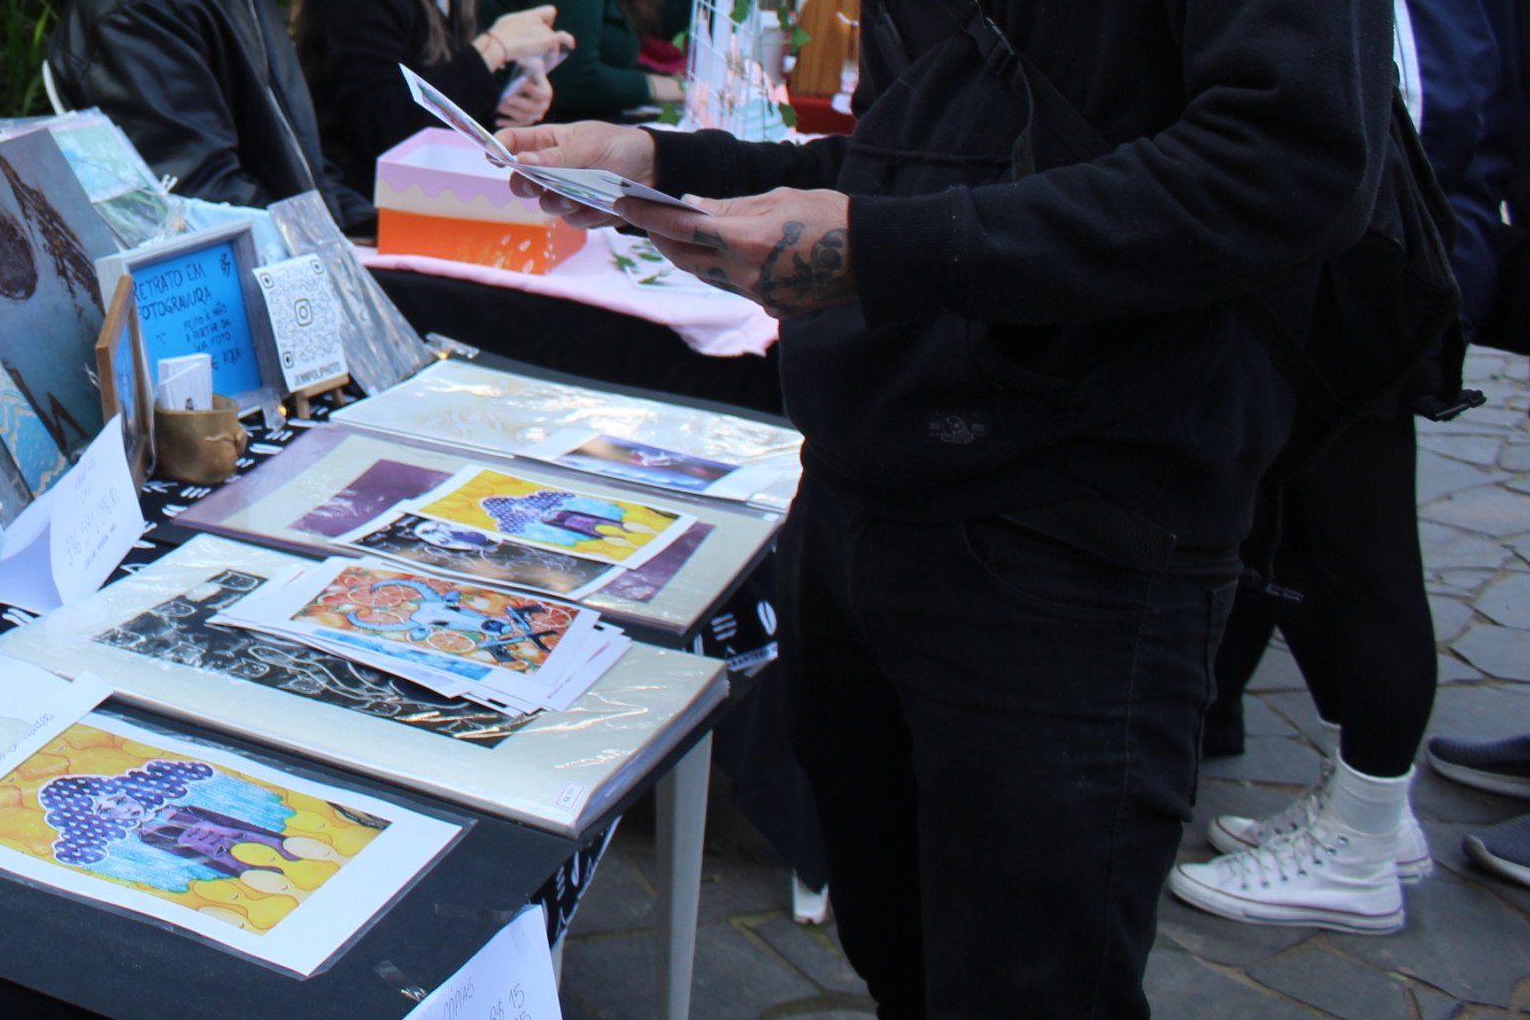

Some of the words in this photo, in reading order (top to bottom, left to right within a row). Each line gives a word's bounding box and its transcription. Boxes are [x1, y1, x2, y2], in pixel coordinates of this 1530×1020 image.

[132, 269, 183, 302] RETRATO
[186, 262, 206, 281] EM
[509, 983, 525, 1009] 15
